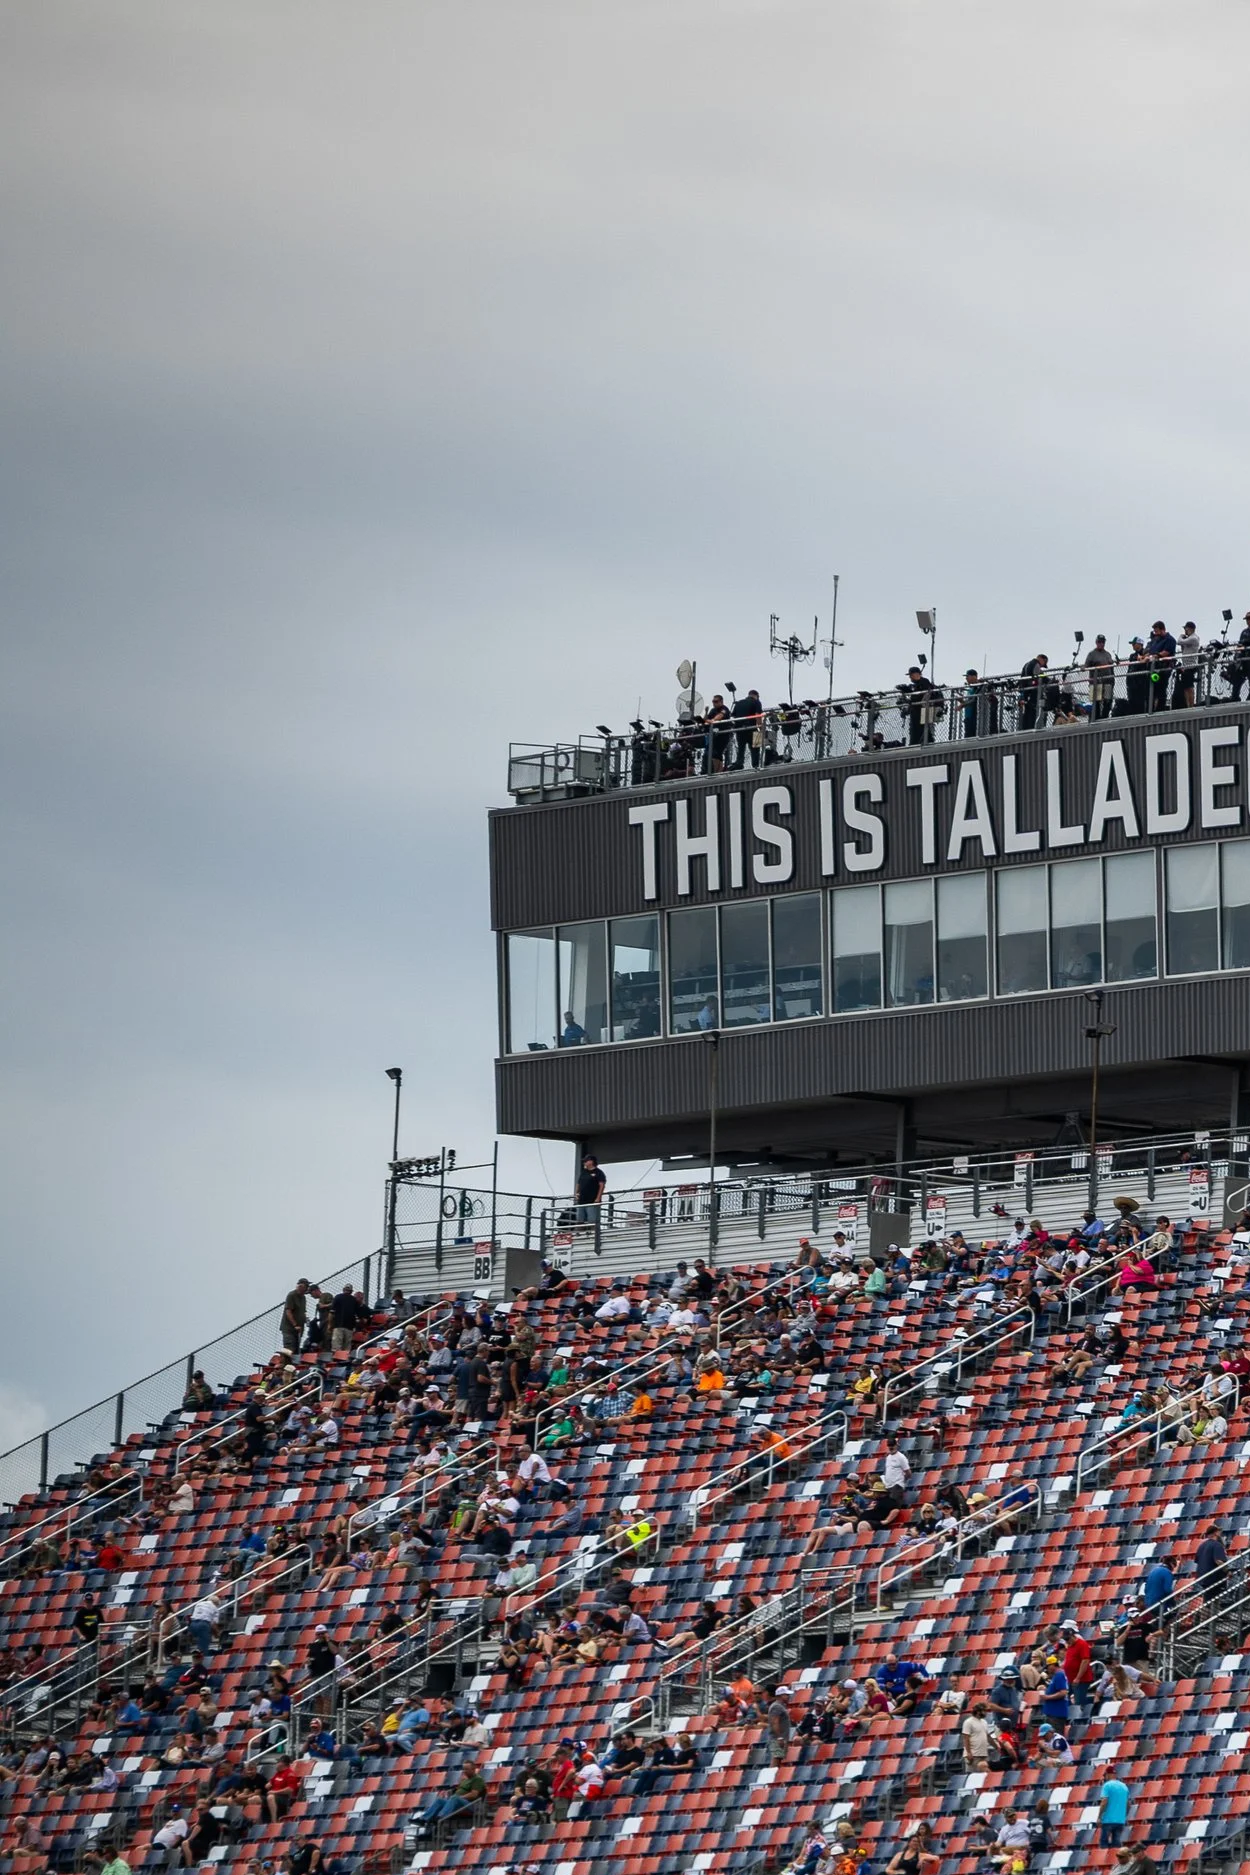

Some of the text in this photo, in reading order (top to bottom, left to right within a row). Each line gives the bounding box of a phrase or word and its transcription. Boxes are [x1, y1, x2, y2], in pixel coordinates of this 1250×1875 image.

[628, 785, 793, 900] THIS
[819, 773, 885, 877] IS
[1199, 1197, 1207, 1210] U
[927, 1223, 935, 1236] U
[474, 1257, 490, 1280] BB
